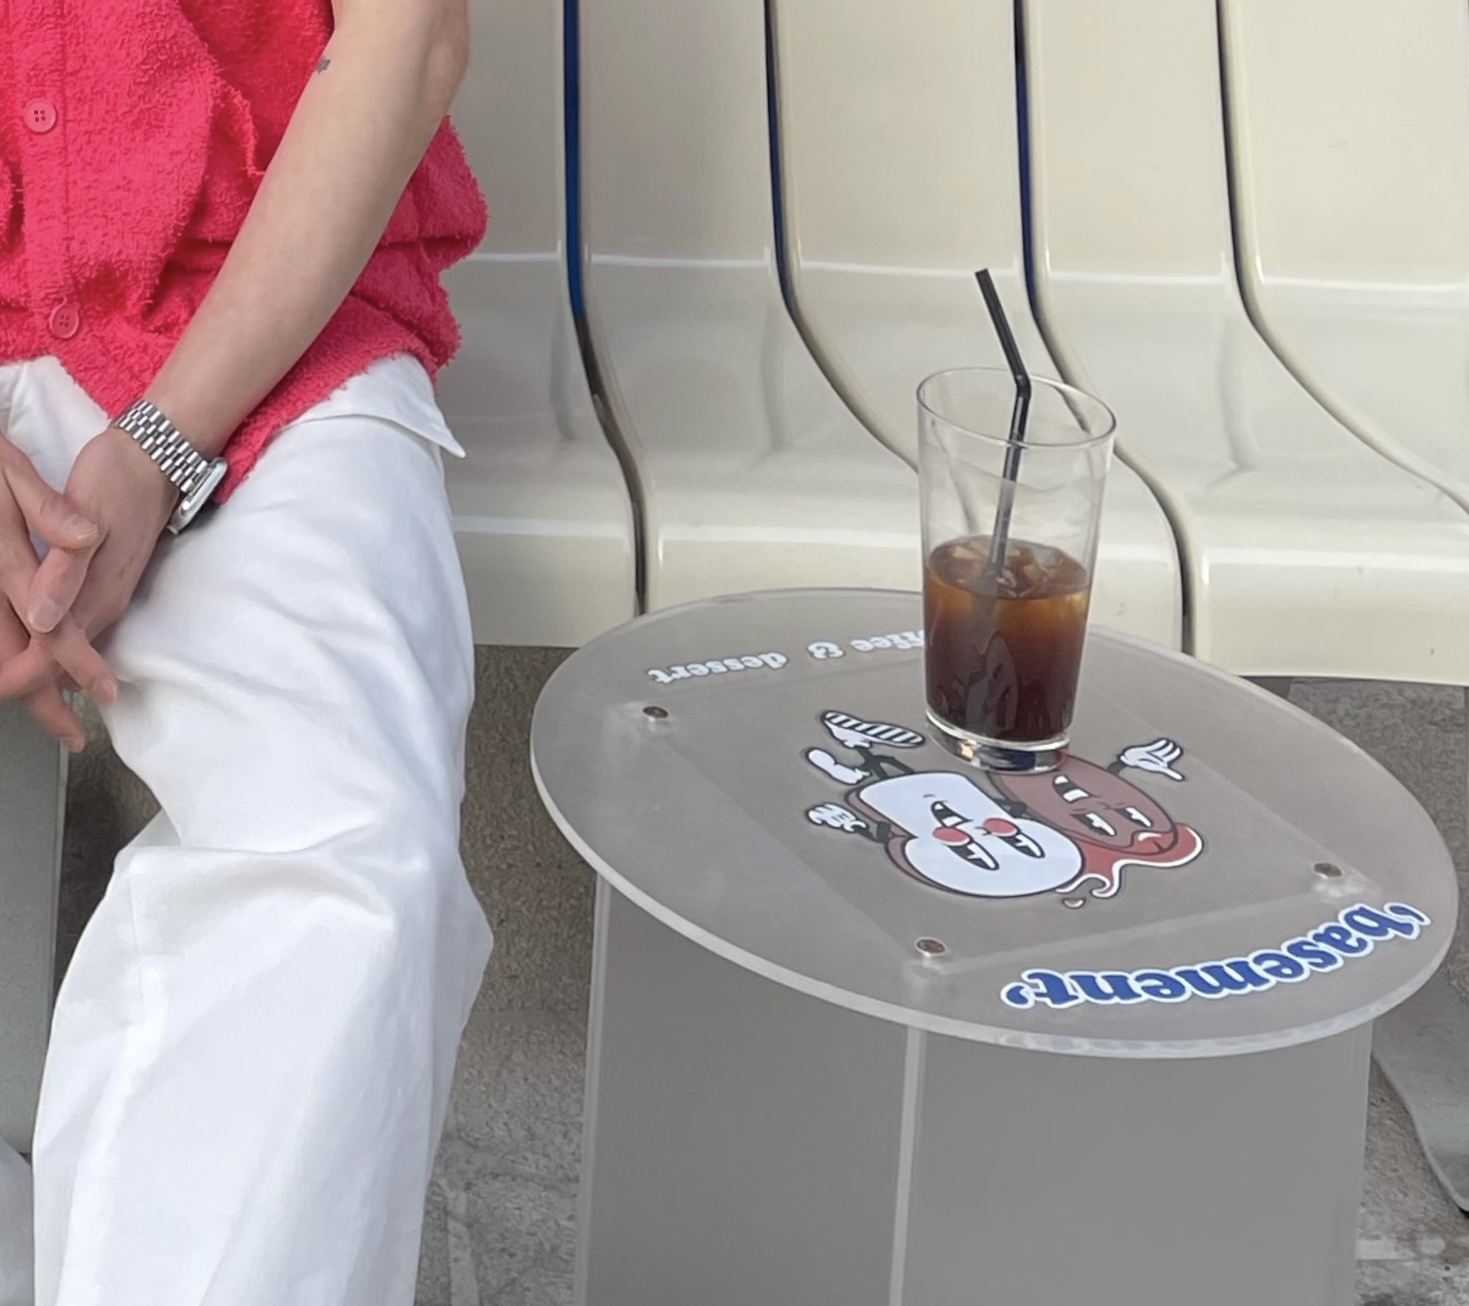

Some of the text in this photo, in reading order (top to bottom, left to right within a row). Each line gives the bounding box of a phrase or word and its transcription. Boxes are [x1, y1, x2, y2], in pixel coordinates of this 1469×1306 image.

[647, 629, 925, 685] ffee & dessert
[1001, 903, 1431, 1009] 'basement'
